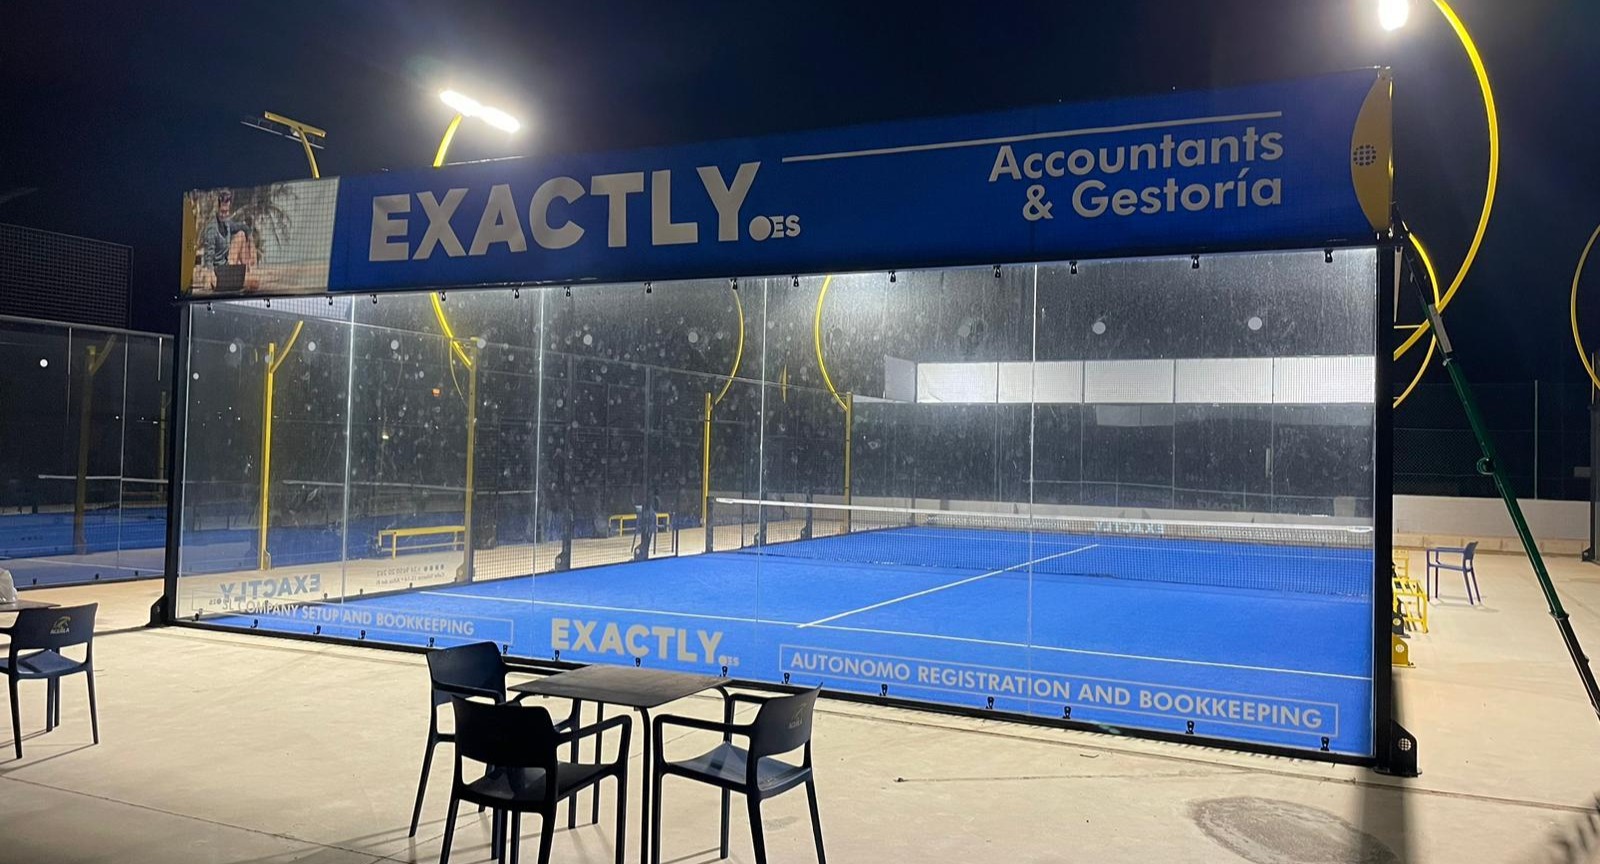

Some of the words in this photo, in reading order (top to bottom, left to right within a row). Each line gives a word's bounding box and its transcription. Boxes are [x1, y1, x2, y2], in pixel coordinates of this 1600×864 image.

[988, 127, 1284, 182] Accountants
[1022, 184, 1054, 222] &
[1071, 168, 1282, 219] Gestoría
[238, 600, 299, 617] COMPANY
[301, 606, 341, 623] SETUP
[342, 609, 372, 626] AND
[376, 612, 475, 637] BOOKKEEPING
[790, 652, 911, 682] AUTONOMO
[917, 667, 1071, 700] REGISTRATION
[1078, 683, 1131, 708] AND
[1139, 690, 1323, 729] BOOKKEEPING
